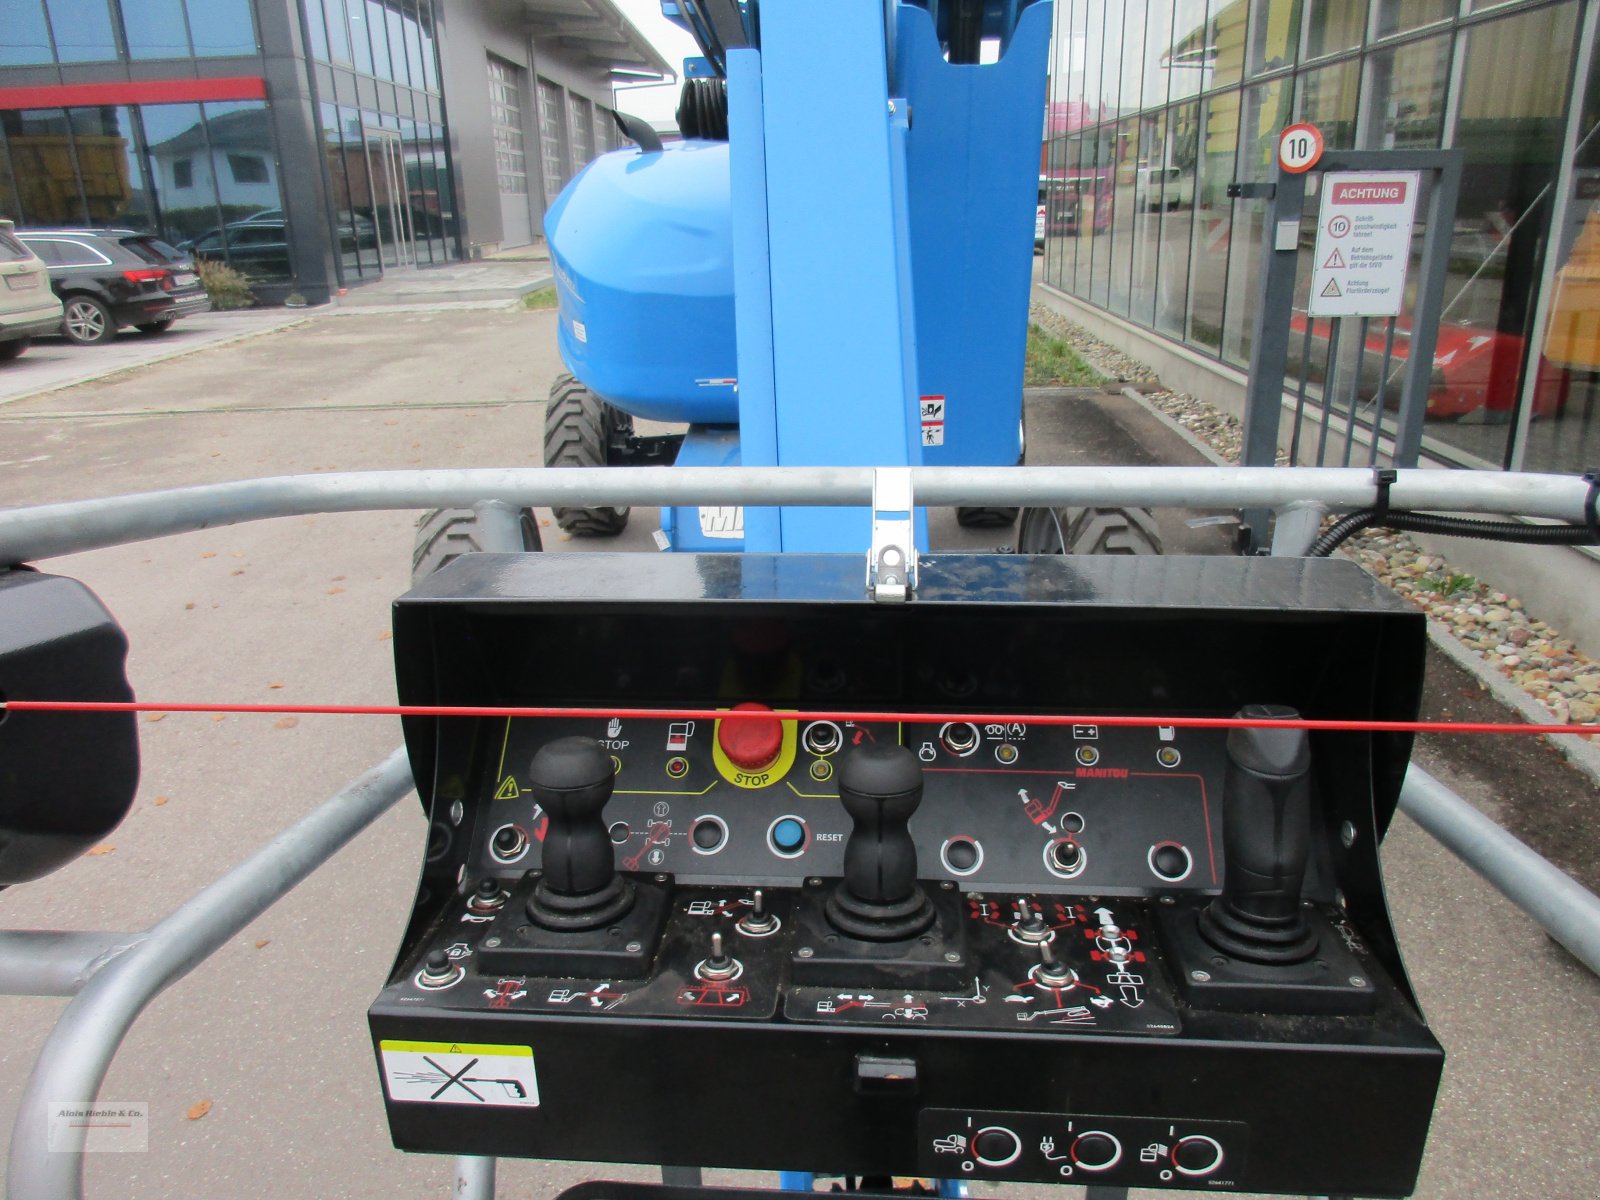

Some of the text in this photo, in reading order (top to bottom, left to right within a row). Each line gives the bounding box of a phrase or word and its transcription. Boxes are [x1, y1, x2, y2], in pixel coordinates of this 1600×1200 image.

[1289, 138, 1307, 159] 10
[1339, 187, 1399, 200] ACHTUNG
[1332, 221, 1346, 232] 10
[1075, 768, 1129, 778] MANITOU
[734, 773, 770, 786] STOP
[816, 833, 844, 841] RESET
